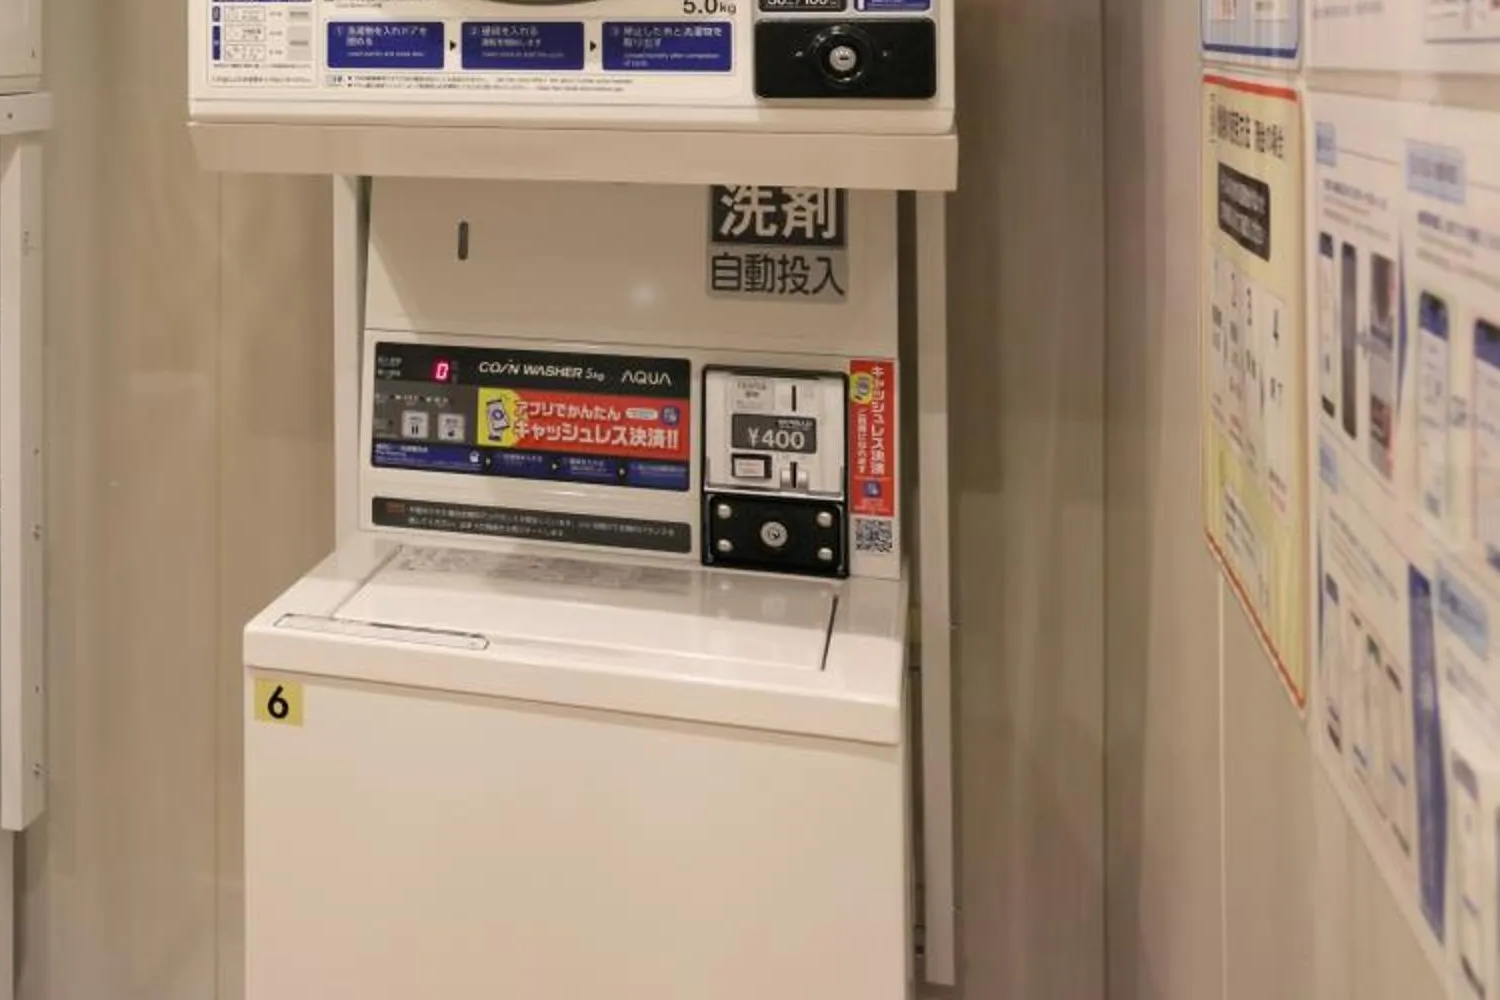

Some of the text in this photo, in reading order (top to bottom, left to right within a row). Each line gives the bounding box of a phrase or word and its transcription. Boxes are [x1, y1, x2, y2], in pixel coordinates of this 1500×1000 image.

[719, 185, 837, 240] 洗剤
[712, 252, 845, 297] 自動投入
[435, 363, 449, 380] 0
[523, 363, 583, 378] WASHER
[621, 370, 673, 386] AQUA
[516, 401, 621, 419] アプリでかんたん
[514, 422, 680, 449] キャッシュレス決済!!
[747, 426, 806, 450] ¥400
[267, 684, 290, 720] 6
